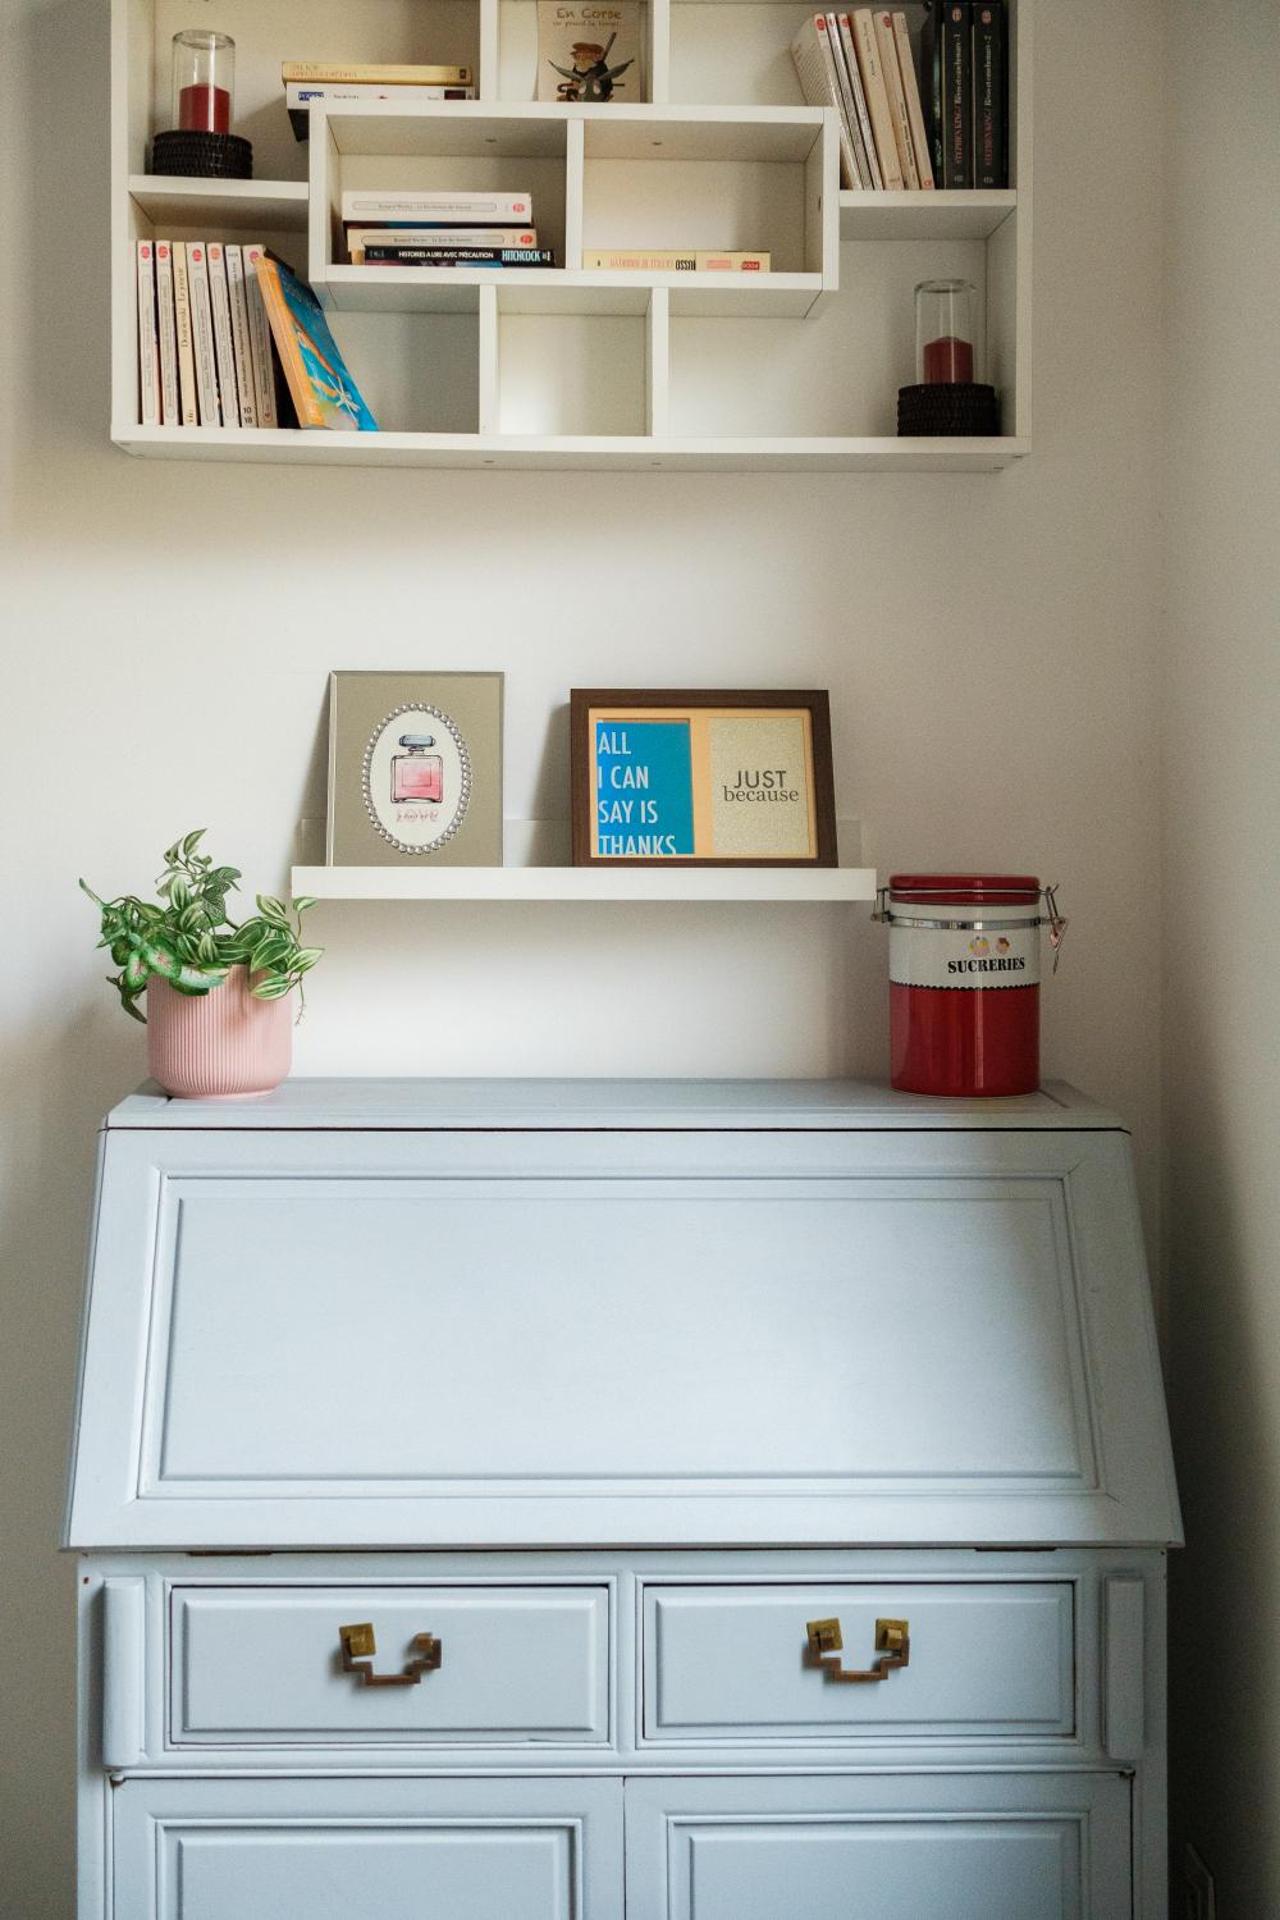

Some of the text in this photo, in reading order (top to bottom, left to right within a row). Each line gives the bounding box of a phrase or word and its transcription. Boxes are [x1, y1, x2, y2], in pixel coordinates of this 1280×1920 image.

[556, 8, 623, 20] En Corse
[501, 249, 540, 262] HITCHCOCK
[598, 732, 632, 755] ALL
[598, 766, 649, 789] I CAN
[734, 770, 787, 789] JUST
[723, 786, 799, 802] because
[598, 801, 659, 824] SAY IS
[599, 835, 677, 855] THANKS
[947, 957, 1025, 974] SUCRERIES
